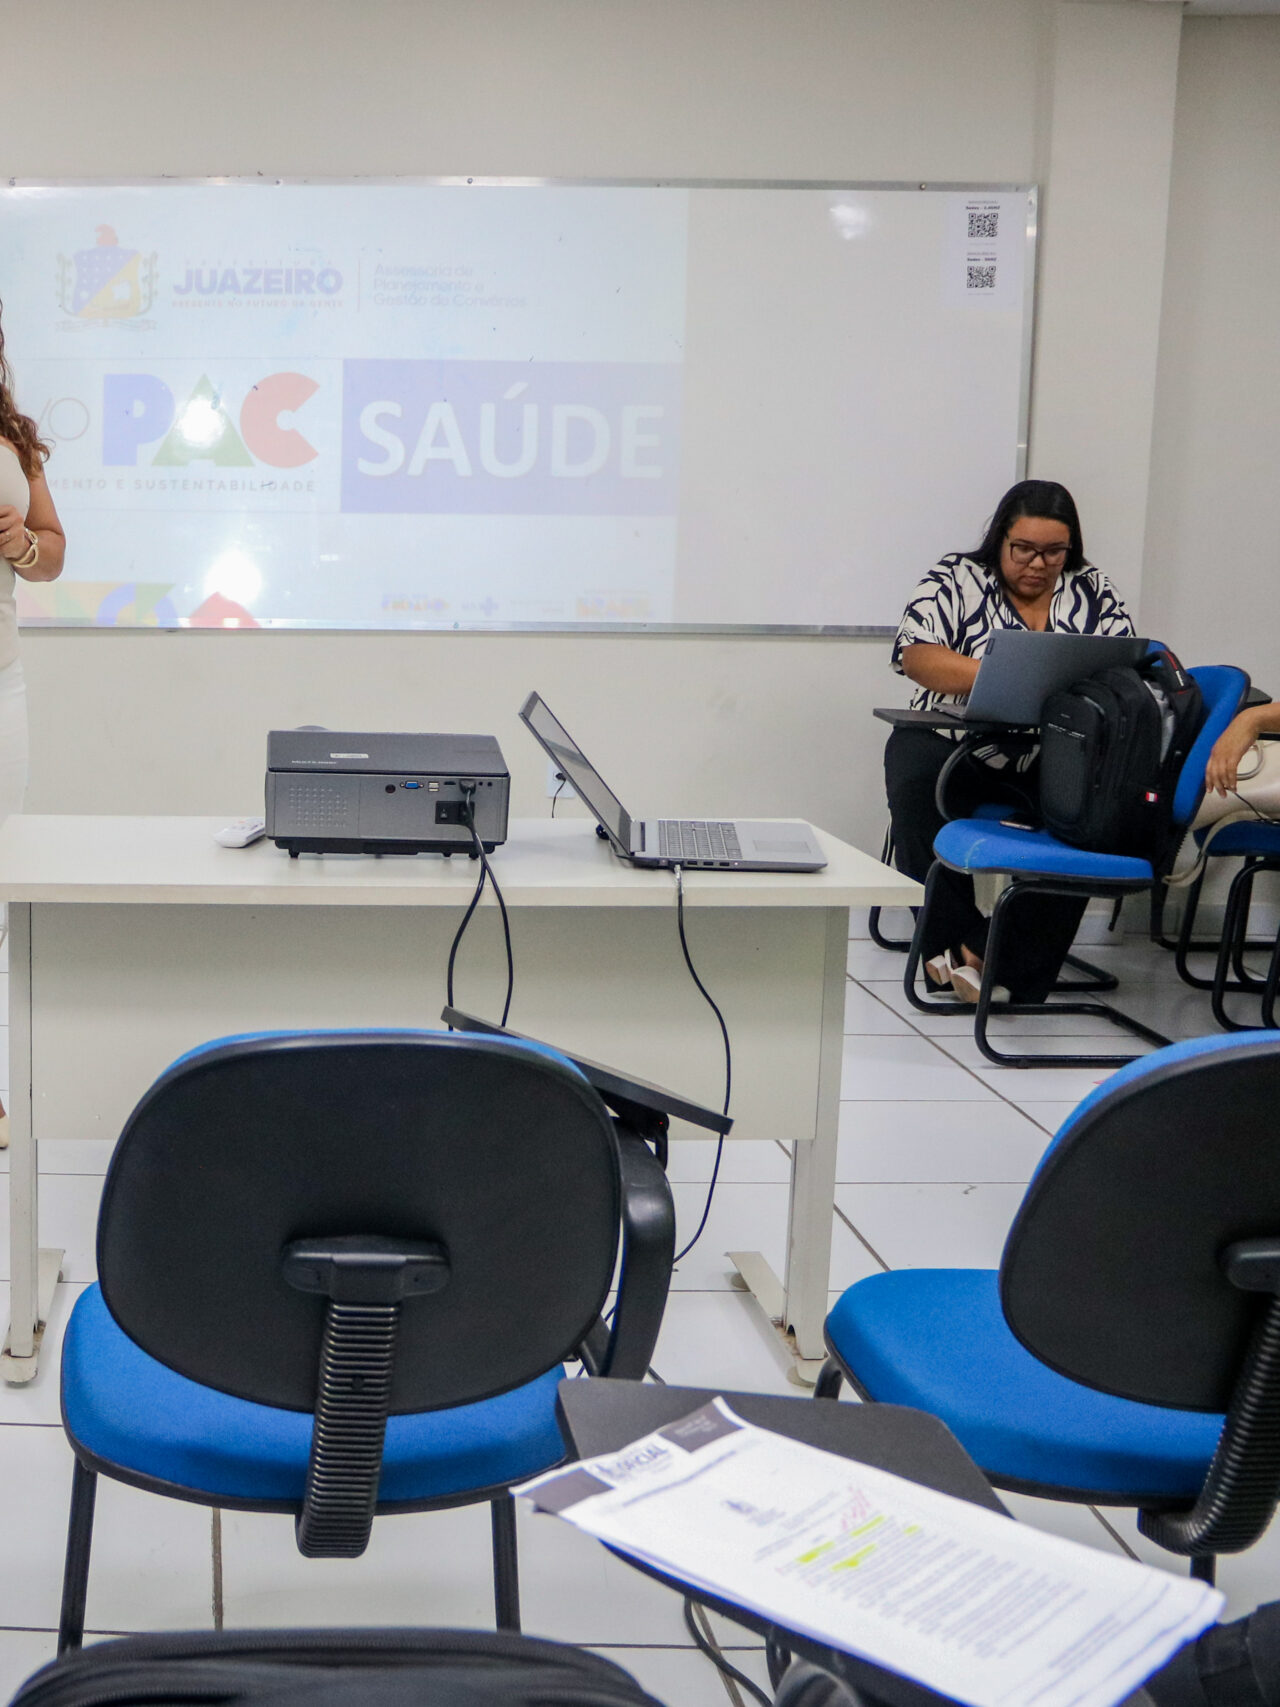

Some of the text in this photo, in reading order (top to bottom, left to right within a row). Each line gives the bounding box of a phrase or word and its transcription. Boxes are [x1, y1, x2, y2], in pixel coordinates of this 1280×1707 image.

[173, 267, 344, 295] JUAZEIRO
[102, 371, 321, 469] PAC
[357, 381, 665, 479] SAÚDE
[49, 479, 107, 490] MENTO
[134, 480, 315, 492] SUSTENTABILIDADE
